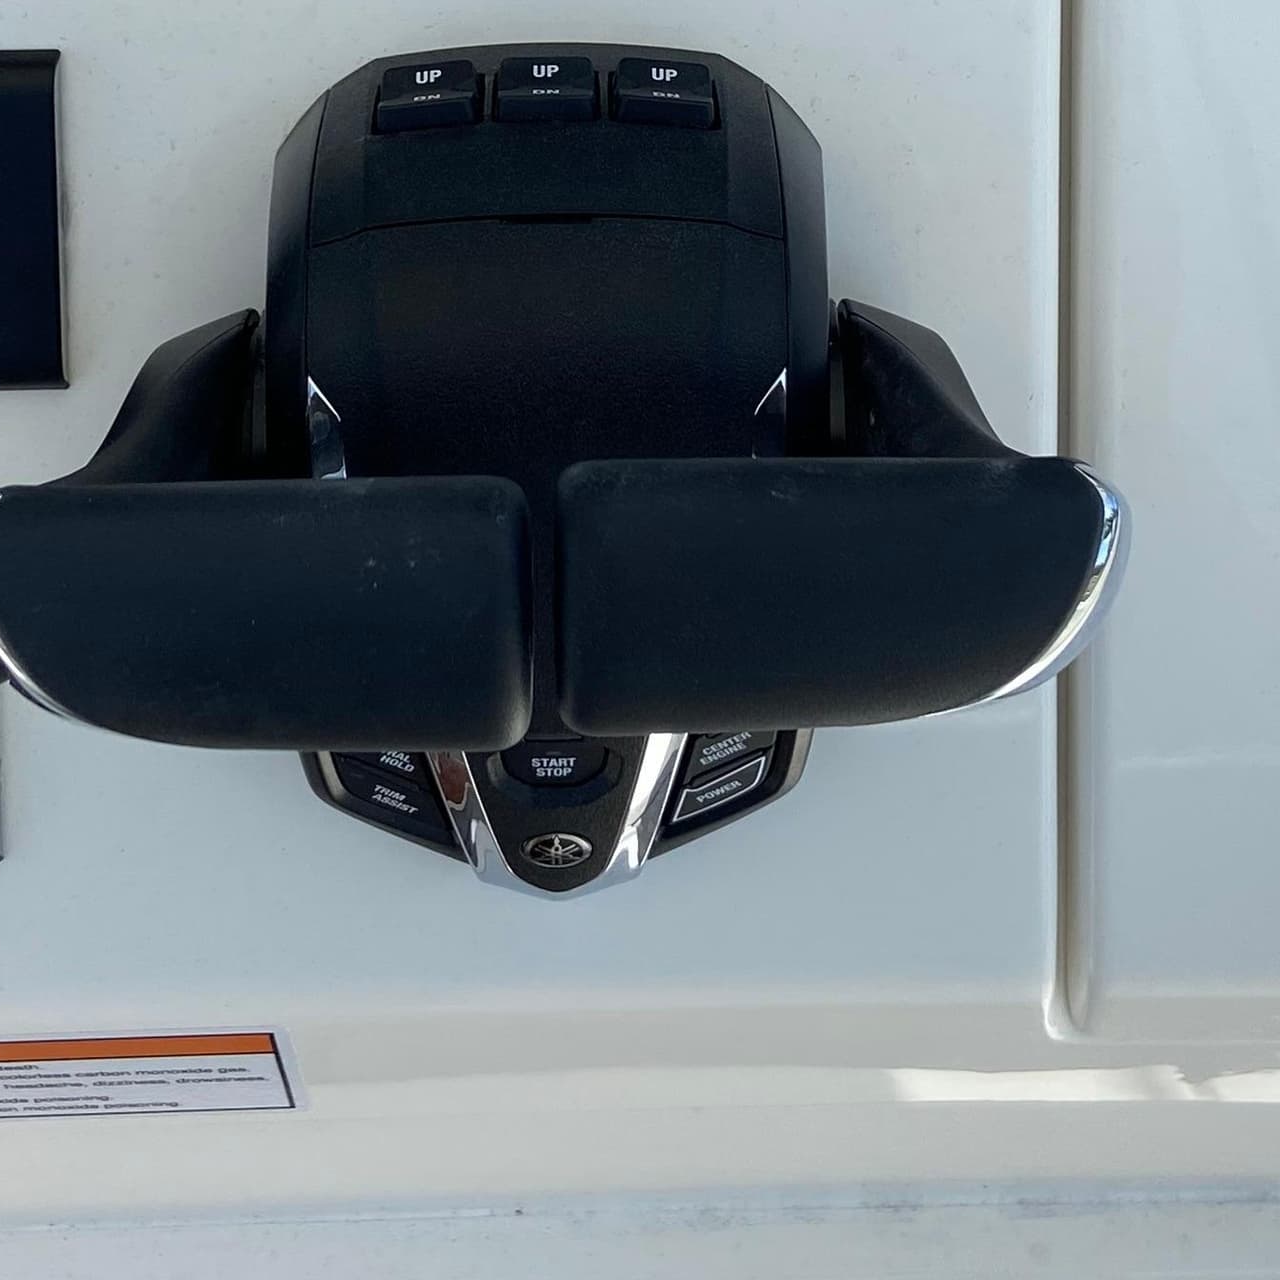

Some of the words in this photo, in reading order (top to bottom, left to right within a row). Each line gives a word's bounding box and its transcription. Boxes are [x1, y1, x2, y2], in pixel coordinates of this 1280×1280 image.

[415, 69, 442, 84] UP
[533, 64, 559, 78] UP
[651, 67, 678, 82] UP
[652, 91, 680, 99] DN
[702, 731, 752, 755] CENTER
[700, 742, 747, 765] ENGINE
[380, 755, 415, 772] HOLD
[531, 757, 576, 769] START
[536, 765, 572, 777] STOP
[374, 784, 406, 801] TRIM
[696, 780, 742, 803] POWER
[371, 793, 419, 813] ASSIST
